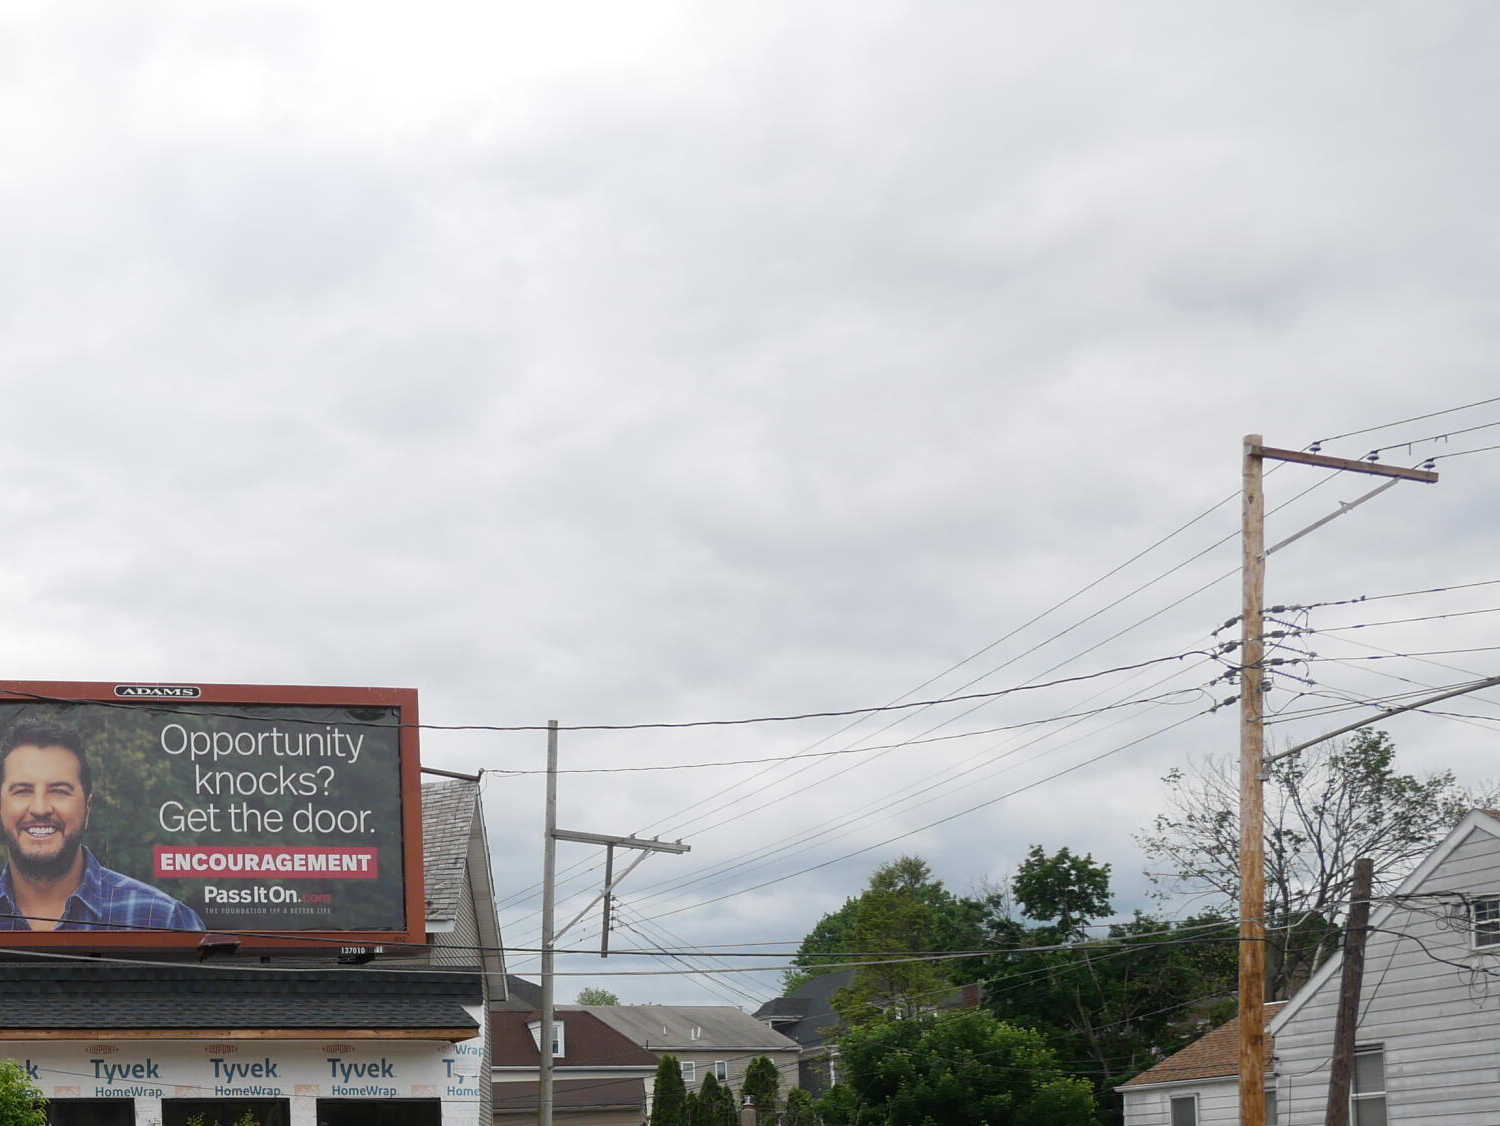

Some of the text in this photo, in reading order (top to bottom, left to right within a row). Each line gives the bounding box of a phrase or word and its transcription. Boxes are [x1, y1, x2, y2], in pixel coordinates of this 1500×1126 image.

[122, 687, 194, 696] ADAMS
[160, 723, 364, 764] Opportunity
[195, 764, 335, 796] knocks?
[159, 801, 376, 834] Get the door.
[160, 853, 372, 872] ENCOURAGEMENT
[204, 885, 332, 904] PassItOn.com
[205, 907, 218, 915] THE
[221, 907, 267, 915] FOUNDATION
[455, 1045, 484, 1057] Wrap
[90, 1058, 160, 1084] Tyvek
[209, 1058, 278, 1083] Tyvek
[327, 1058, 394, 1083] Tyvek
[95, 1086, 163, 1098] HomeWrap
[215, 1085, 282, 1098] HomeWrap
[332, 1085, 397, 1098] HomeWrap
[447, 1086, 480, 1096] Home
